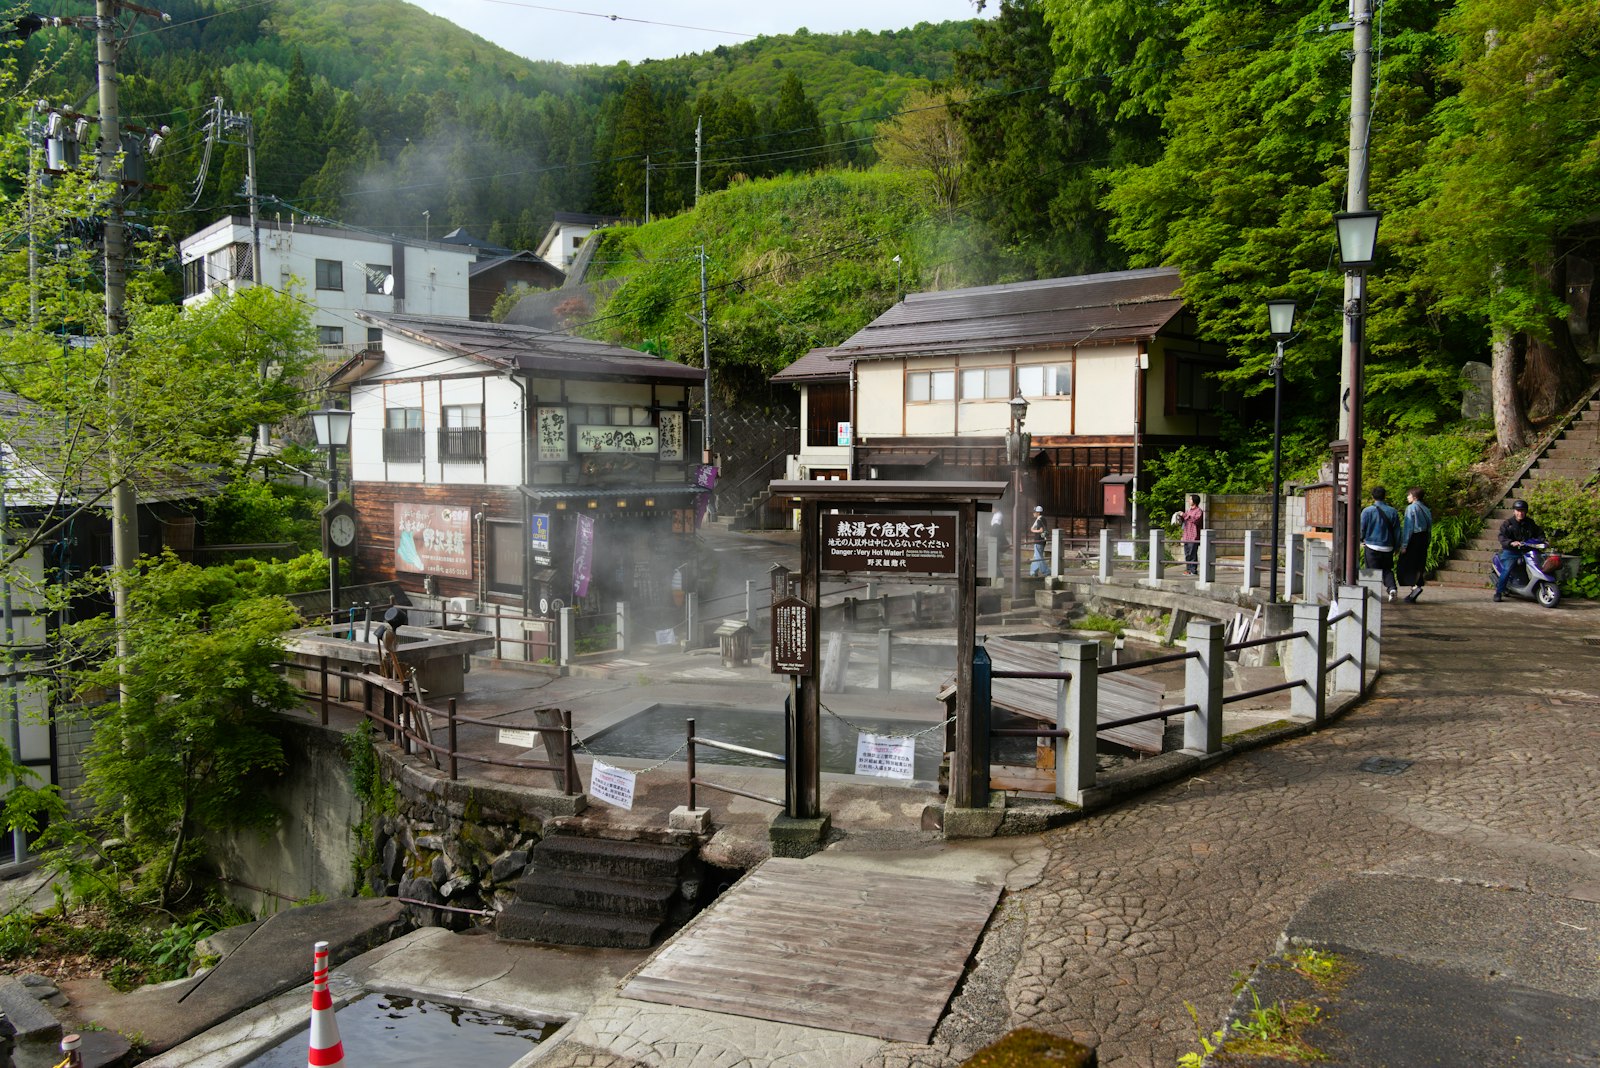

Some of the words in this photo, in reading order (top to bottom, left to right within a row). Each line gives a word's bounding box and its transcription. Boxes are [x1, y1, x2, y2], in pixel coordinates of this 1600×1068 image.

[837, 521, 940, 539] 熱湯で危険です
[827, 538, 950, 549] 地元の人以外は中に入らないでください
[884, 549, 905, 557] Water!
